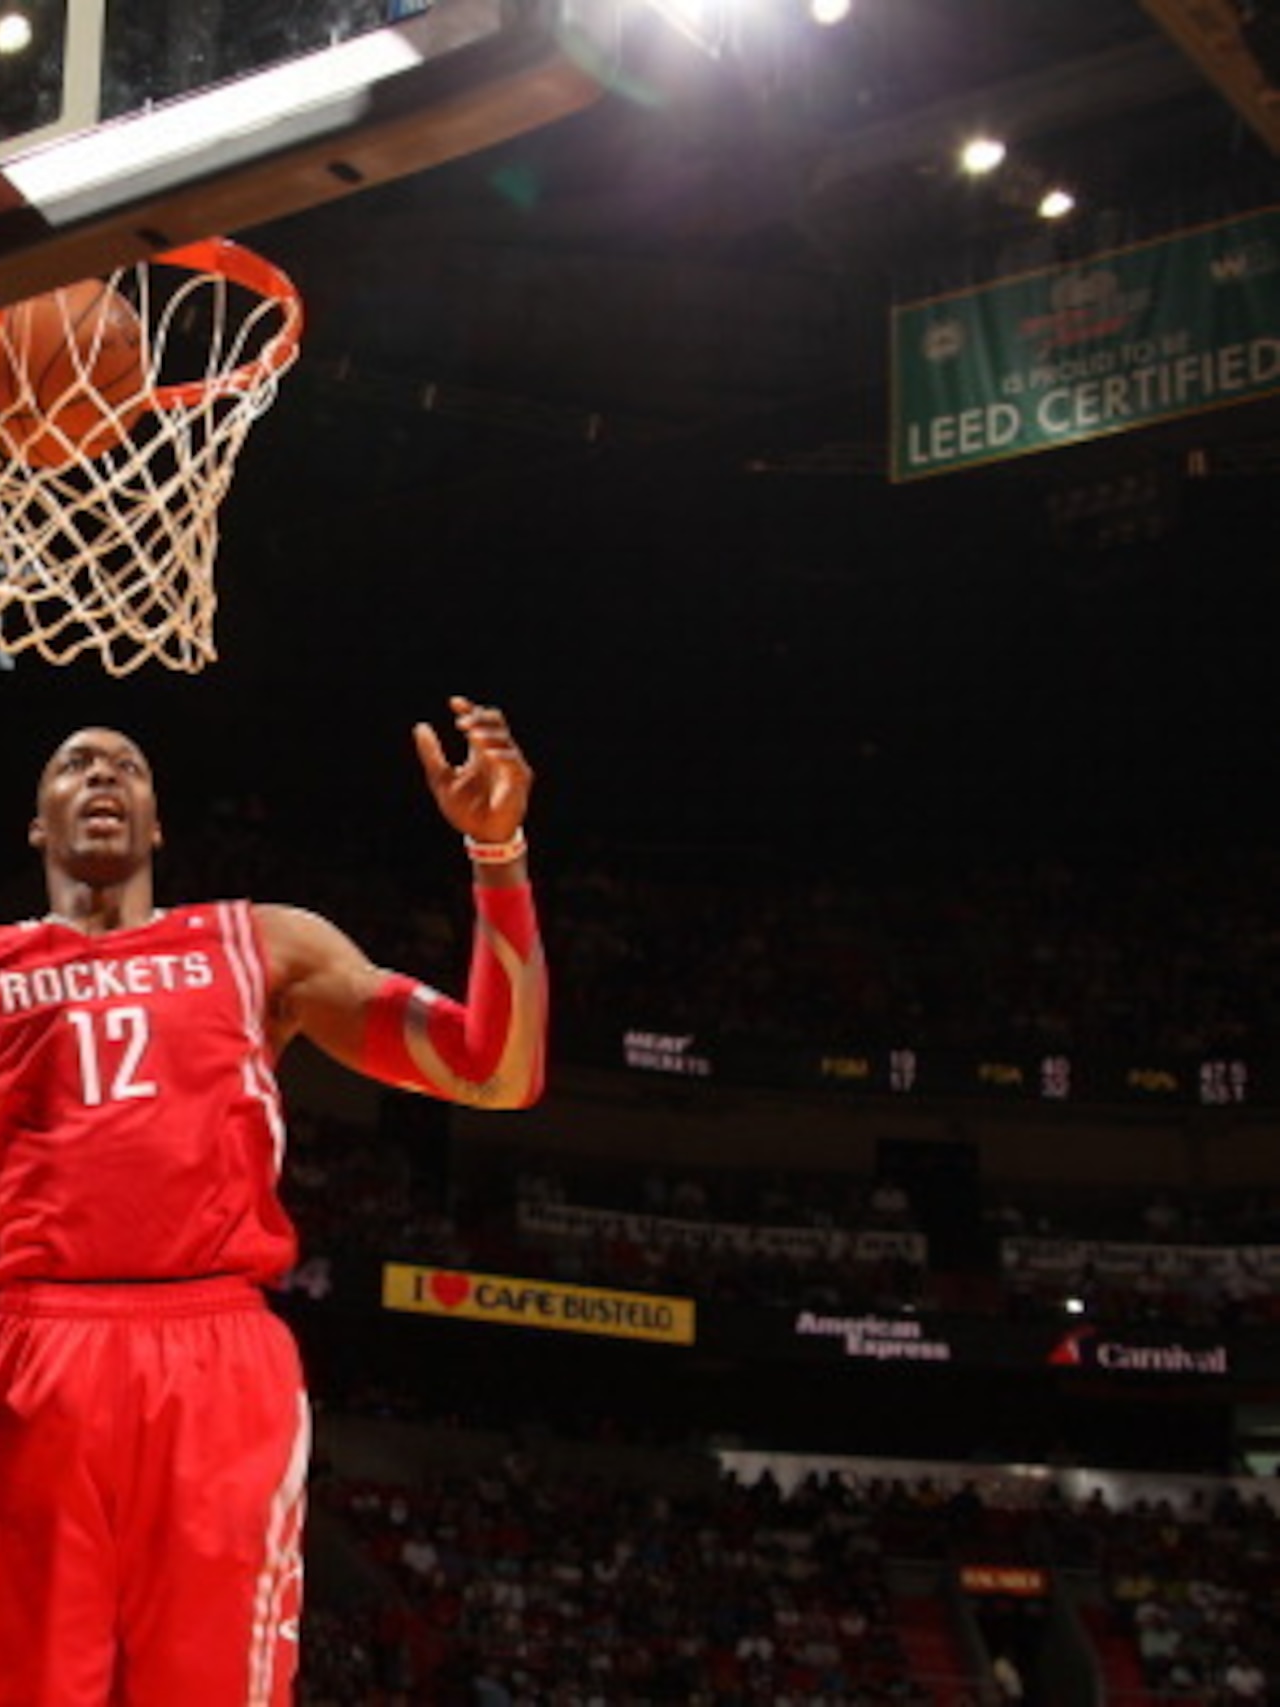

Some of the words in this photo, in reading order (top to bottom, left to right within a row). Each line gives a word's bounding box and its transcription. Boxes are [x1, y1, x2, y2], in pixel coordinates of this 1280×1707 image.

[908, 402, 1020, 464] LEED
[1037, 338, 1280, 433] CERTIFIED
[67, 1006, 158, 1107] 12
[412, 1273, 425, 1301] I
[475, 1282, 556, 1316] CAFE
[563, 1293, 674, 1331] BUSTELO
[795, 1310, 921, 1340] American
[843, 1333, 952, 1363] Express
[1095, 1342, 1229, 1375] Carnival
